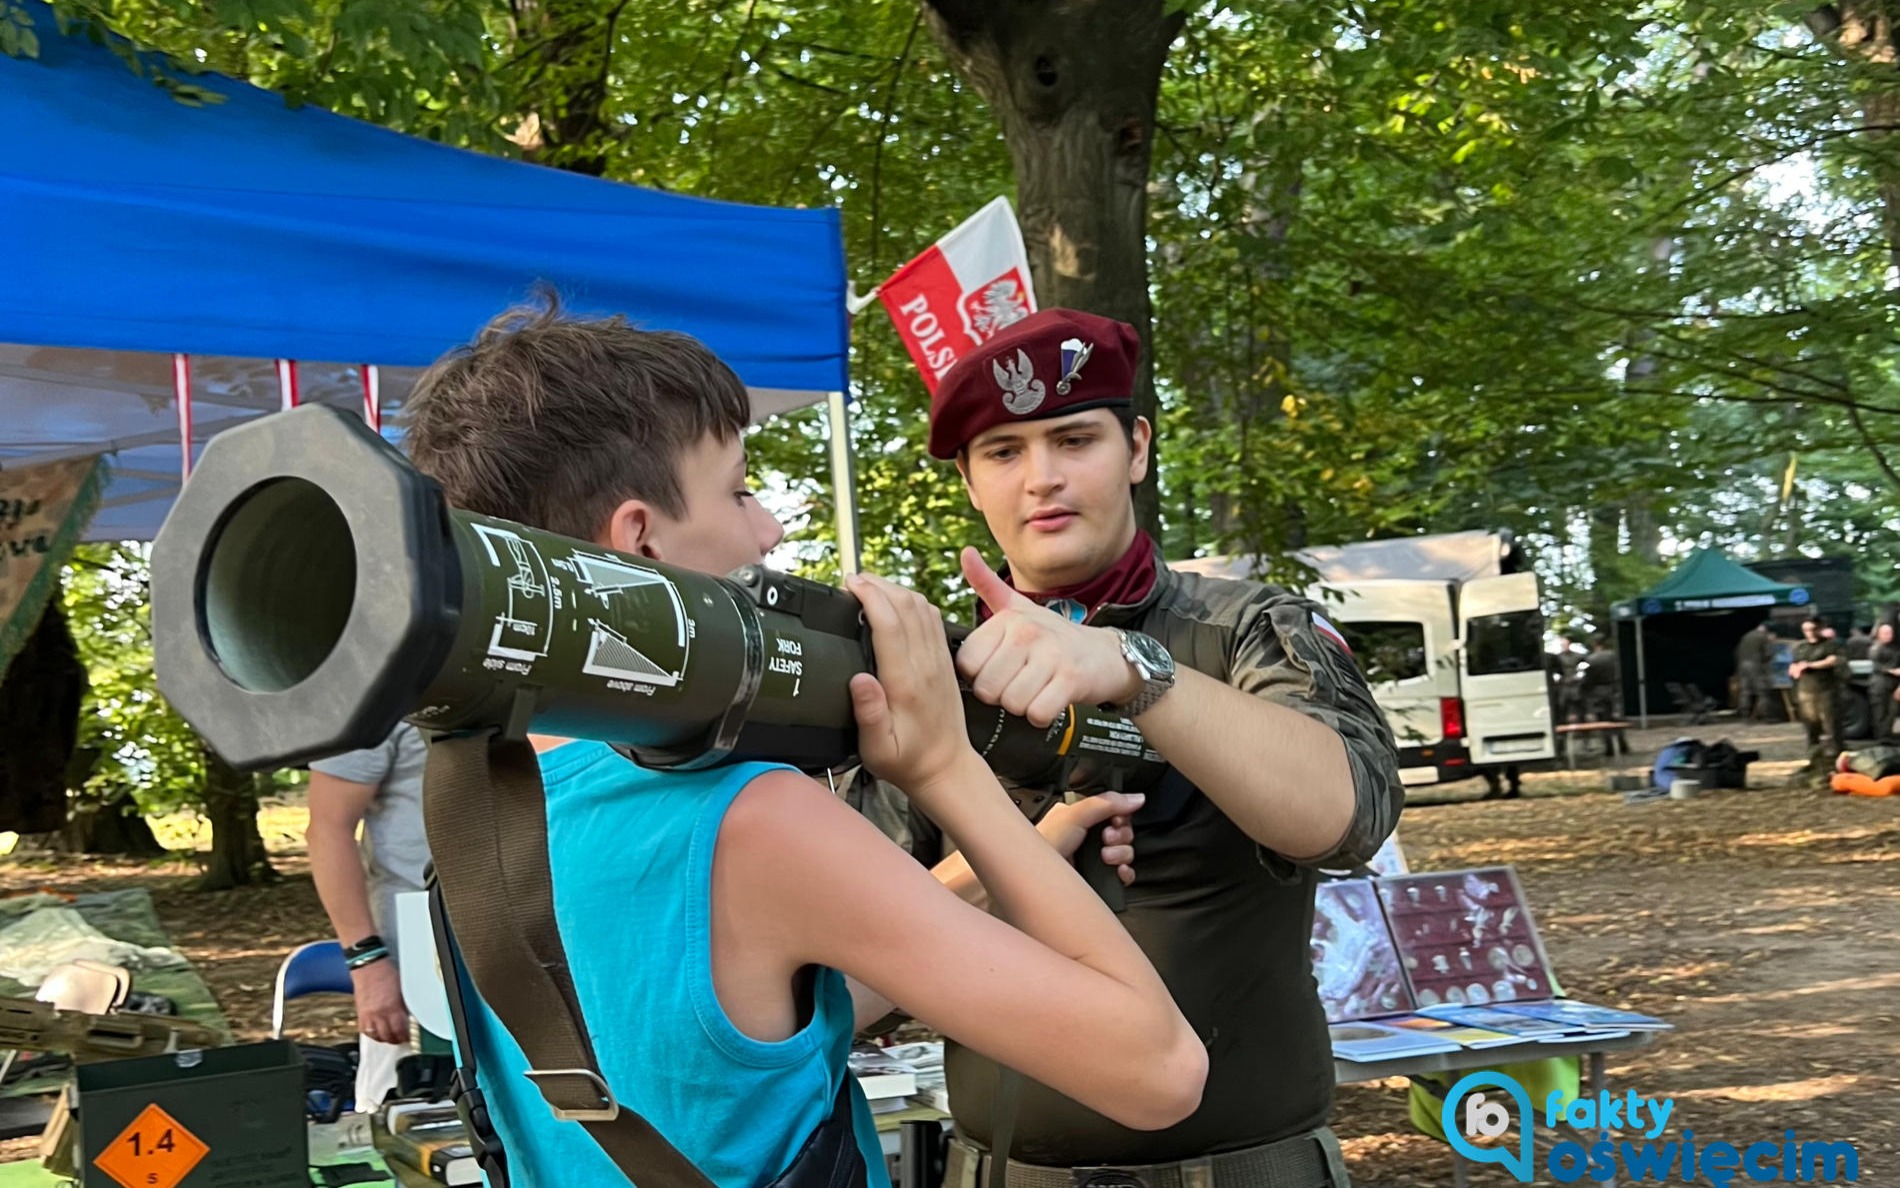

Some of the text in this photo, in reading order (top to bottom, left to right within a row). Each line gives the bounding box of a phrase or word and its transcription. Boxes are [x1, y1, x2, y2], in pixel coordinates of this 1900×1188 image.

[776, 638, 802, 656] FORK
[483, 657, 532, 676] From side
[768, 656, 803, 676] SAFETY
[606, 679, 657, 696] From above
[792, 678, 801, 697] 1
[127, 1128, 176, 1157] 1.4
